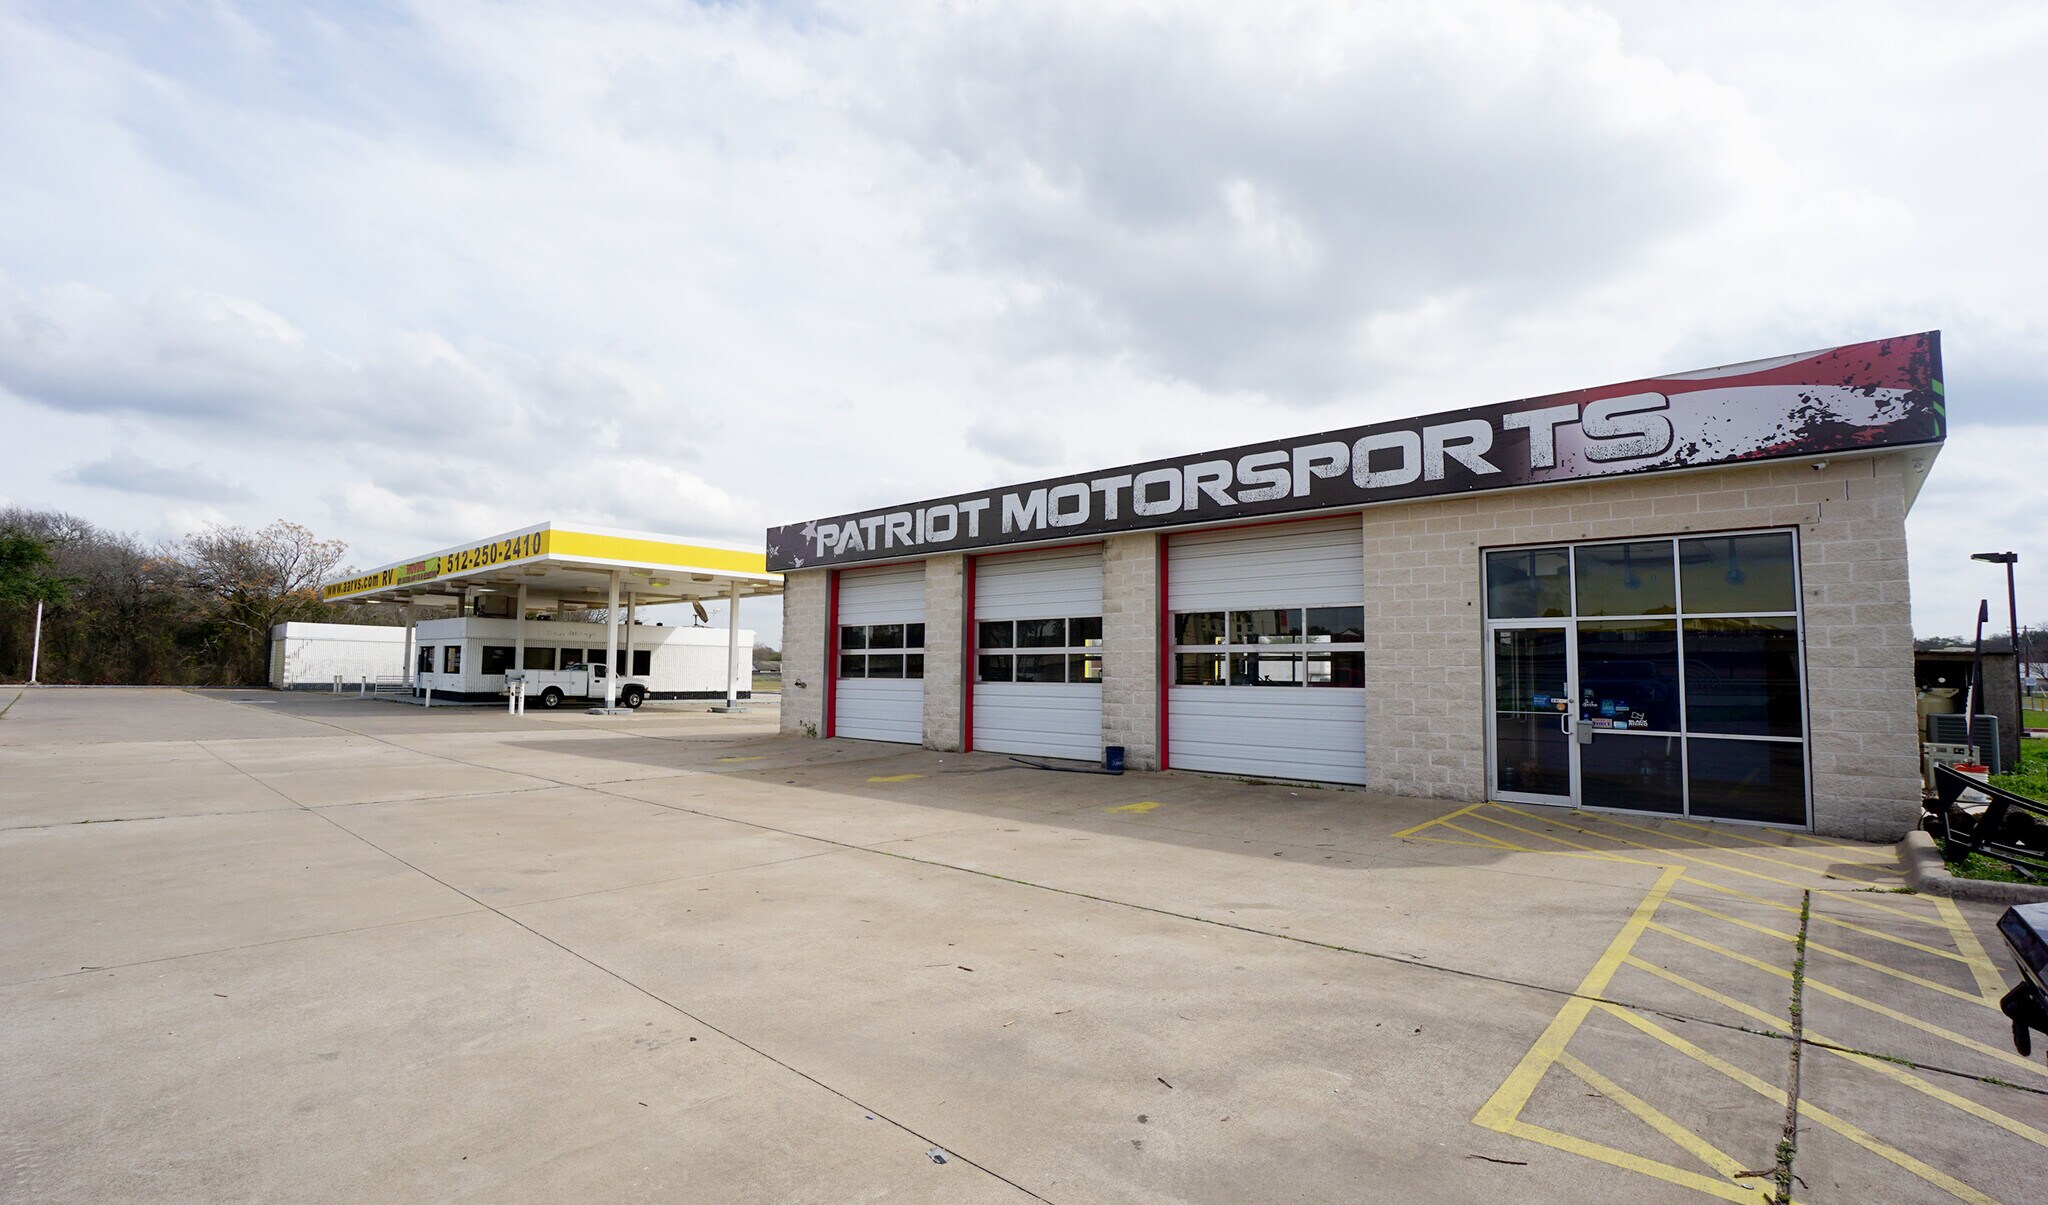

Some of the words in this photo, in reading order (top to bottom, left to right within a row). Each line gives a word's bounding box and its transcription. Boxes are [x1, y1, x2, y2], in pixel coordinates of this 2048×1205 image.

[816, 498, 990, 558] PATRIOT
[1002, 392, 1673, 534] MOTORSPORTS
[382, 568, 394, 586] RV
[447, 531, 541, 573] 512-250-2410
